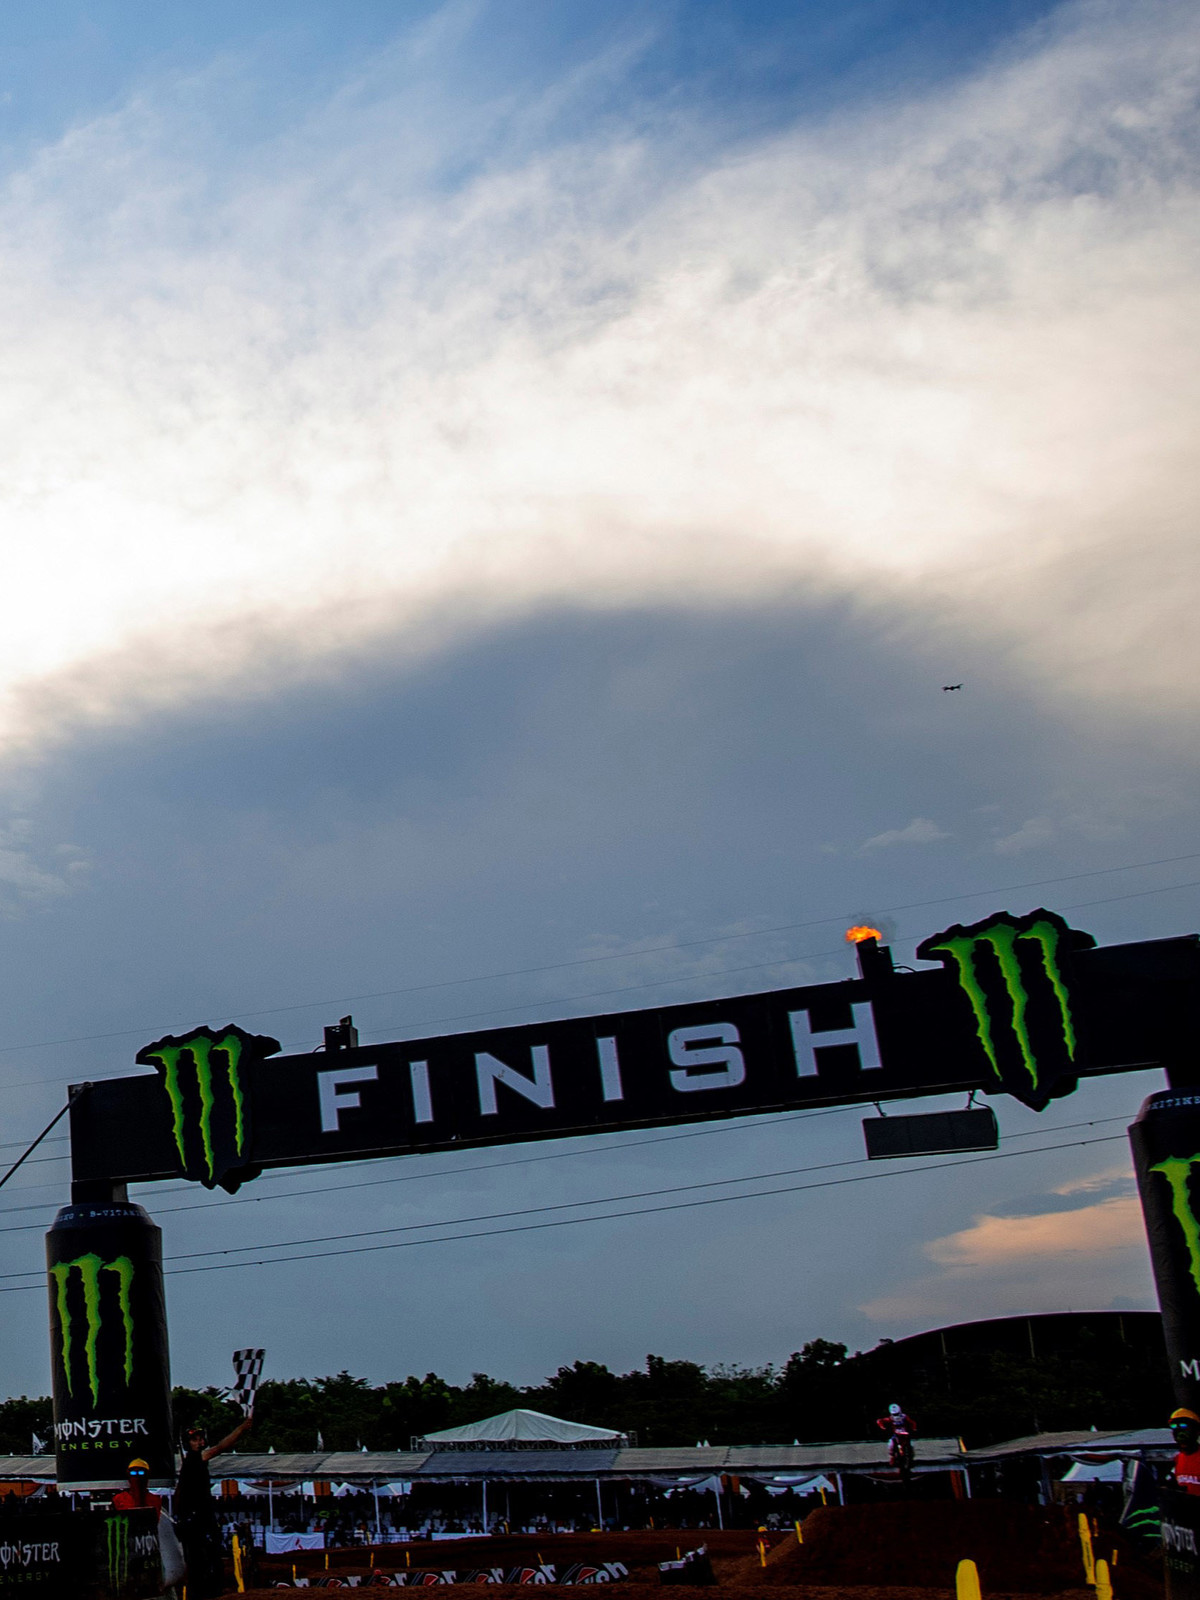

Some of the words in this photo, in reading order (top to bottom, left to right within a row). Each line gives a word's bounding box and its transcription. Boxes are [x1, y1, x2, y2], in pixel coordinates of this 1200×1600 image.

[316, 1000, 883, 1133] FINISH
[53, 1417, 150, 1441] MONSTER
[60, 1440, 134, 1452] ENERGY
